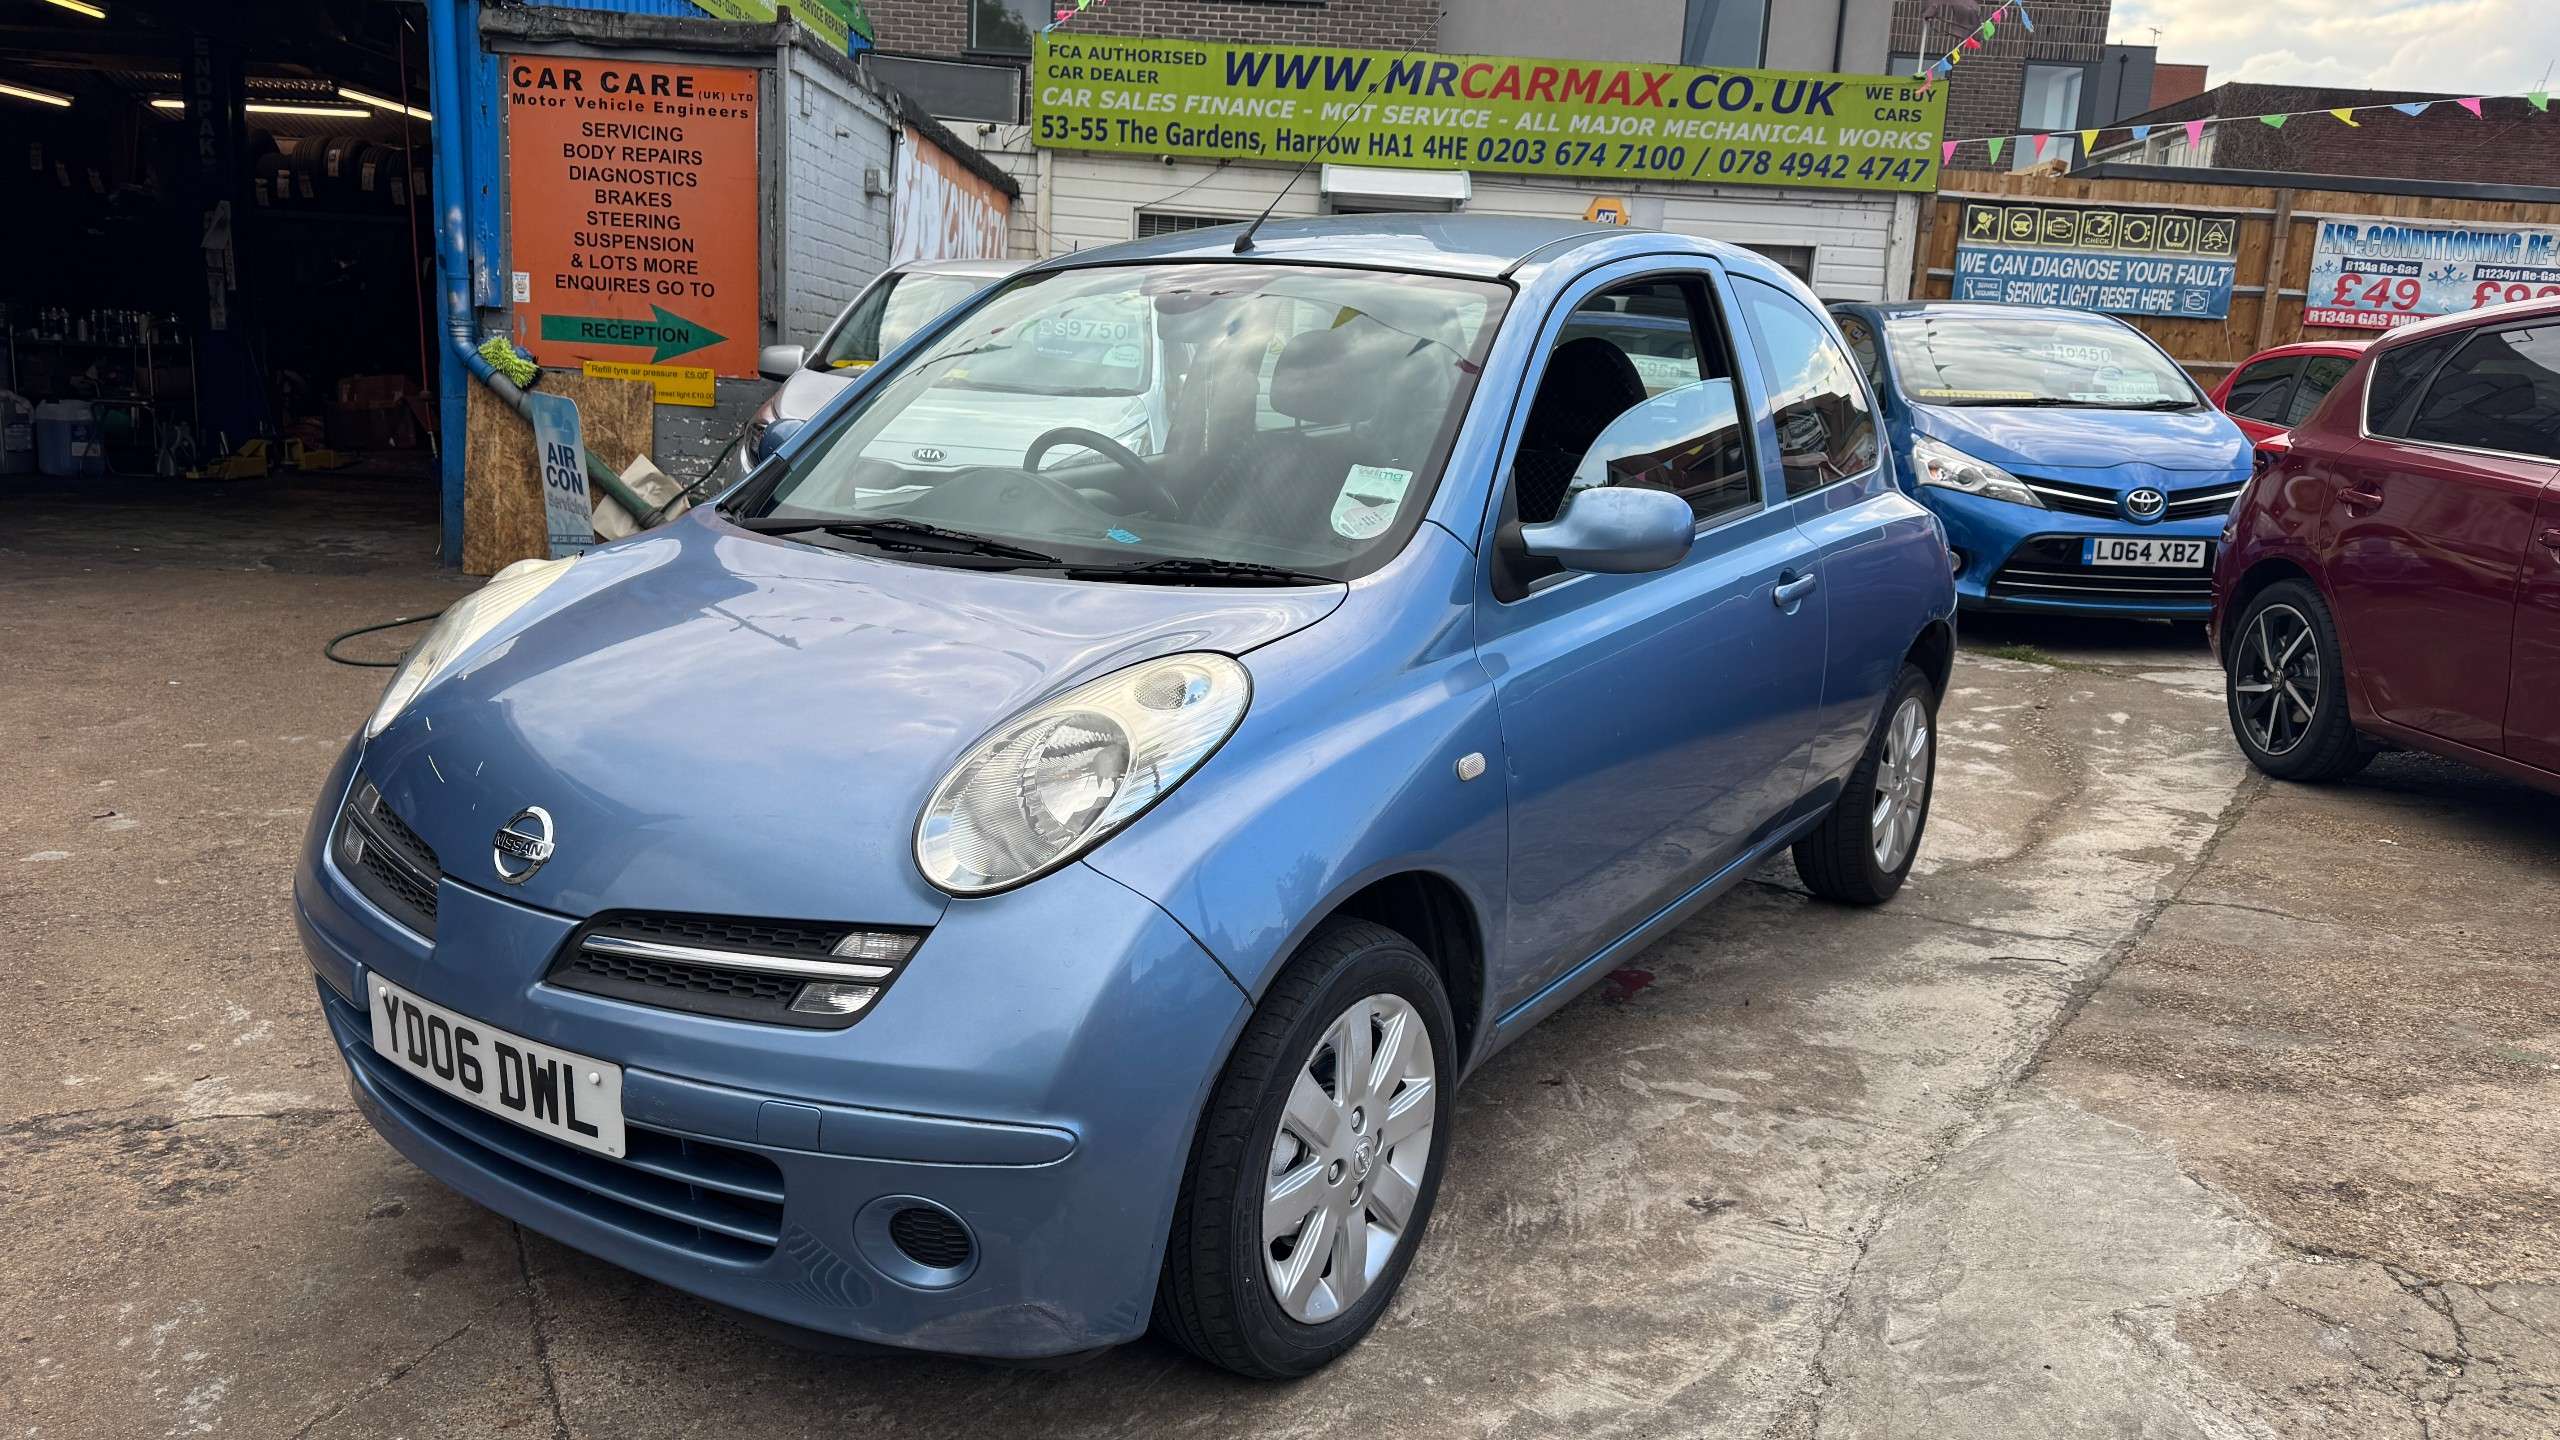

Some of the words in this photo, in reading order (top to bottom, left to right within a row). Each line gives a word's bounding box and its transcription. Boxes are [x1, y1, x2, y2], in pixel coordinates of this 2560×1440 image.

[1049, 44, 1080, 60] FCA
[1088, 46, 1207, 66] AUTHORISED
[512, 66, 583, 91] CAR
[600, 70, 694, 98] CARE
[698, 90, 725, 102] (UK)
[731, 92, 753, 103] LTD
[1049, 65, 1082, 80] CAR
[1089, 67, 1159, 84] DEALER
[1225, 51, 1844, 117] WWW.MRCARMAX.CO.UK
[512, 92, 565, 108] Motor
[575, 96, 645, 112] Vehicle
[654, 100, 749, 119] Engineers
[1866, 86, 1893, 101] WE
[1899, 87, 1936, 103] BUY
[1042, 87, 1092, 109] CAR
[1100, 90, 1177, 113] SALES
[1184, 95, 1297, 119] FINANCE
[1321, 101, 1375, 124] MOT
[1382, 104, 1492, 129] SERVICE
[1514, 112, 1560, 133] ALL
[1568, 114, 1653, 137] MAJOR
[1662, 119, 1827, 146] MECHANICAL
[1839, 128, 1932, 151] WORKS
[1874, 107, 1922, 123] CARS
[582, 121, 683, 142] SERVICING
[563, 143, 616, 160] BODY
[622, 146, 703, 166] REPAIRS
[1041, 115, 1108, 142] 53-55
[1117, 118, 1158, 145] The
[1165, 121, 1266, 157] Gardens,
[1276, 128, 1360, 155] Harrow
[1369, 132, 1414, 158] HA1
[1423, 134, 1467, 160] 4HE
[1477, 136, 1546, 165] 0203
[1555, 141, 1606, 168] 674
[1616, 144, 1685, 171] 7100
[1691, 147, 1710, 176] /
[1719, 148, 1771, 176] 078
[1779, 152, 1847, 180] 4942
[1856, 155, 1929, 183] 4747
[569, 166, 698, 187] DIAGNOSTICS
[595, 189, 672, 208] BRAKES
[587, 210, 681, 230] STEERING
[1597, 212, 1617, 224] ADT
[574, 232, 694, 252] SUSPENSION
[2319, 223, 2521, 264] AIR-CONDITIONING
[2524, 233, 2560, 266] RE-
[571, 254, 583, 268] &
[590, 254, 637, 271] LOTS
[644, 257, 698, 275] MORE
[1960, 252, 1985, 274] WE
[1990, 255, 2027, 277] CAN
[2030, 257, 2121, 281] DIAGNOSE
[2125, 262, 2172, 284] YOUR
[2175, 265, 2231, 287] FAULT
[2345, 261, 2378, 272] R134a
[2379, 262, 2419, 275] Re-Gas
[2477, 268, 2521, 281] R1234yf
[2522, 270, 2560, 281] Re-Gas
[556, 274, 650, 294] ENQUIRES
[657, 280, 685, 296] GO
[692, 282, 715, 298] TO
[2006, 281, 2059, 304] SERVICE
[2059, 284, 2098, 307] LIGHT
[2098, 287, 2138, 310] RESET
[2141, 290, 2175, 311] HERE
[2331, 273, 2421, 311] £49
[2308, 310, 2355, 325] R134a
[2358, 312, 2388, 326] GAS
[581, 322, 689, 344] RECEPTION
[592, 365, 611, 374] Refill
[613, 367, 628, 375] tyre
[676, 391, 690, 399] light
[548, 442, 577, 470] AIR
[917, 448, 942, 460] KIA
[546, 465, 584, 495] CON
[2096, 540, 2152, 561] LO64
[2158, 542, 2201, 562] XBZ
[494, 833, 544, 857] NISSAN
[382, 994, 484, 1094] YD06
[494, 1040, 599, 1138] DWL
